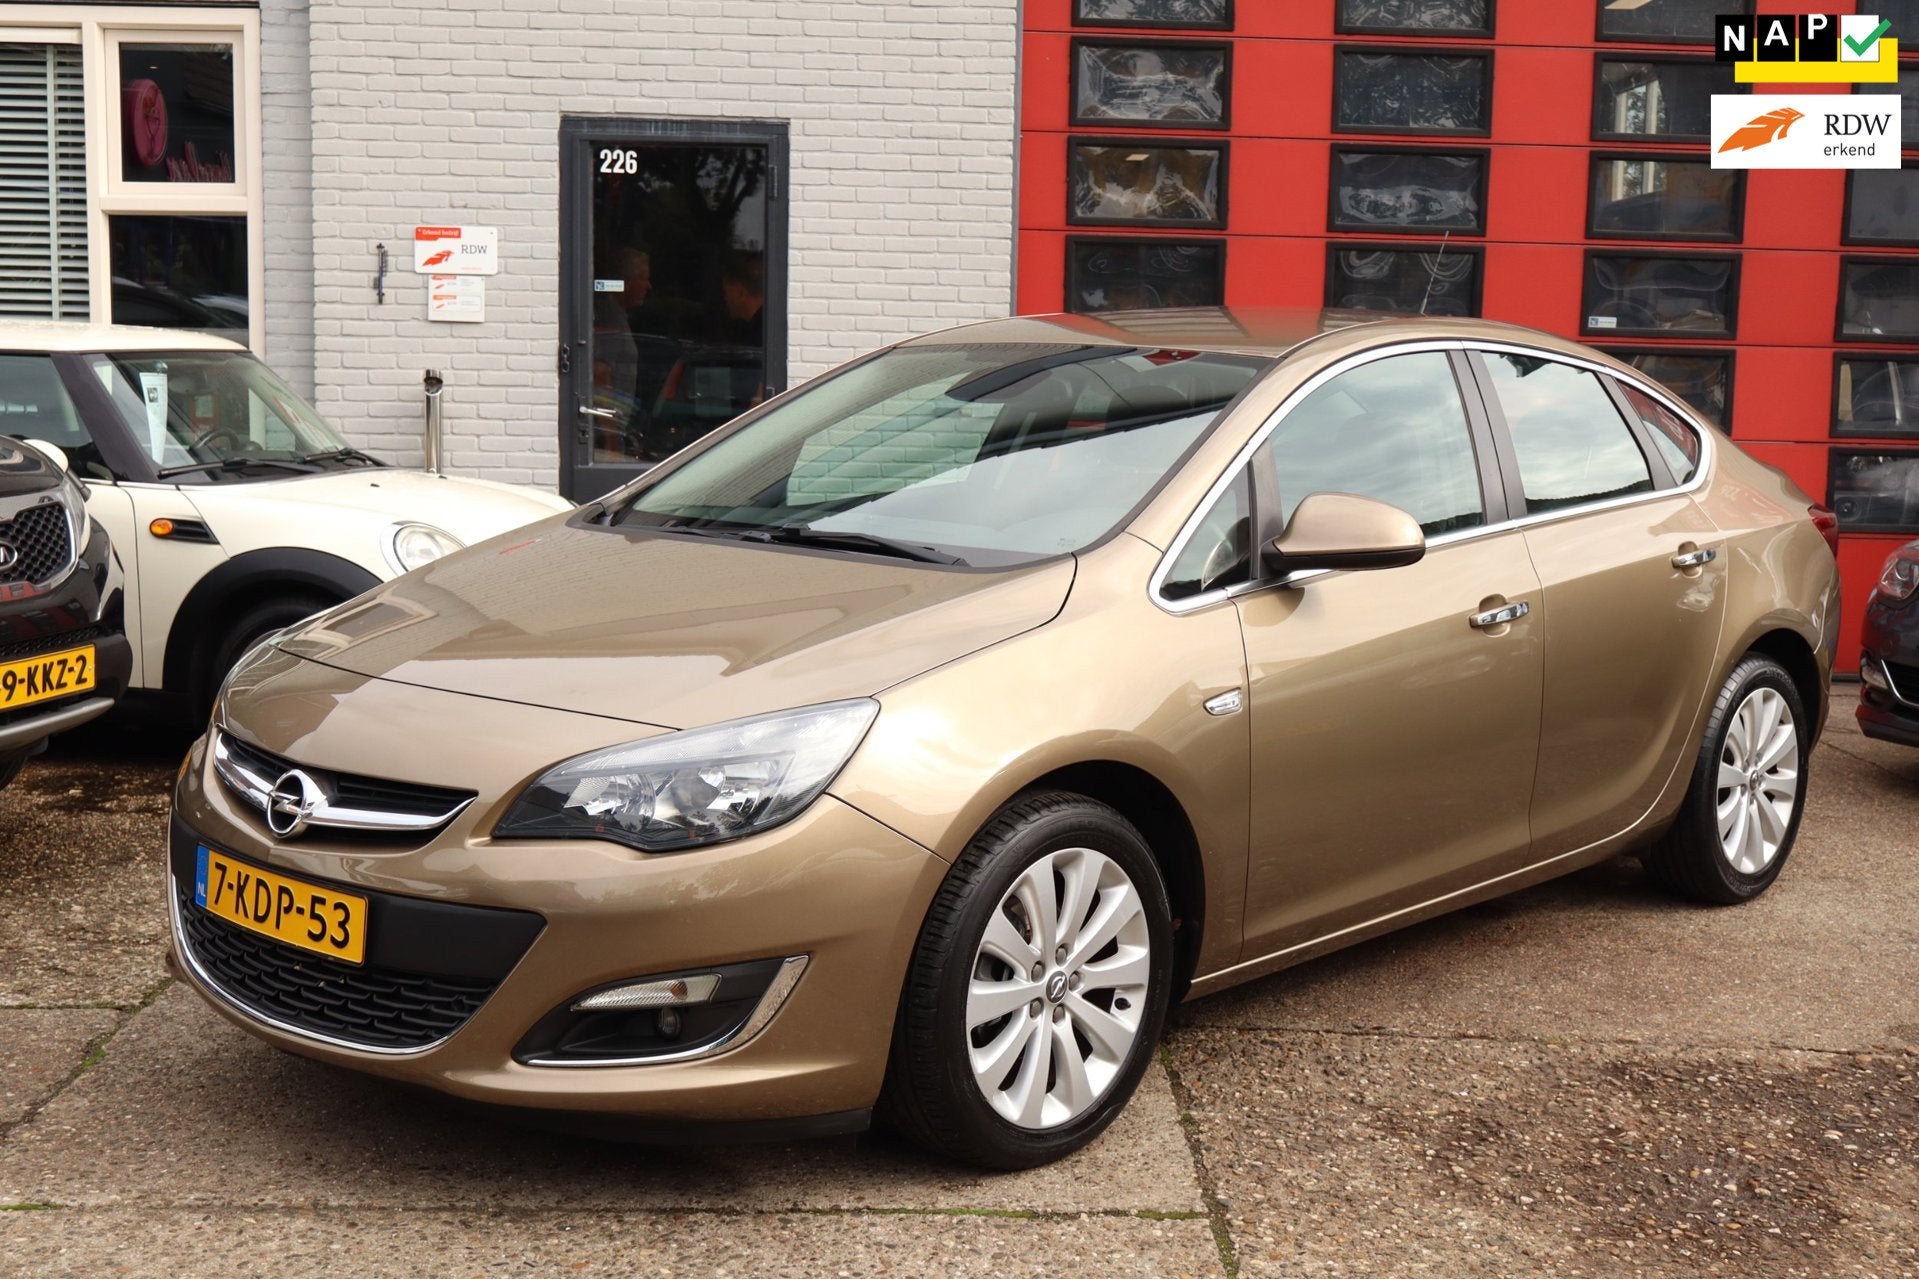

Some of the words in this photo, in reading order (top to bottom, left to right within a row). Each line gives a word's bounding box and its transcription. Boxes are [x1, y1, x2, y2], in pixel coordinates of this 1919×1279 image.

[599, 148, 638, 175] 226
[461, 244, 488, 254] RDW
[197, 882, 206, 898] NL
[214, 861, 351, 949] 7-KDP-53
